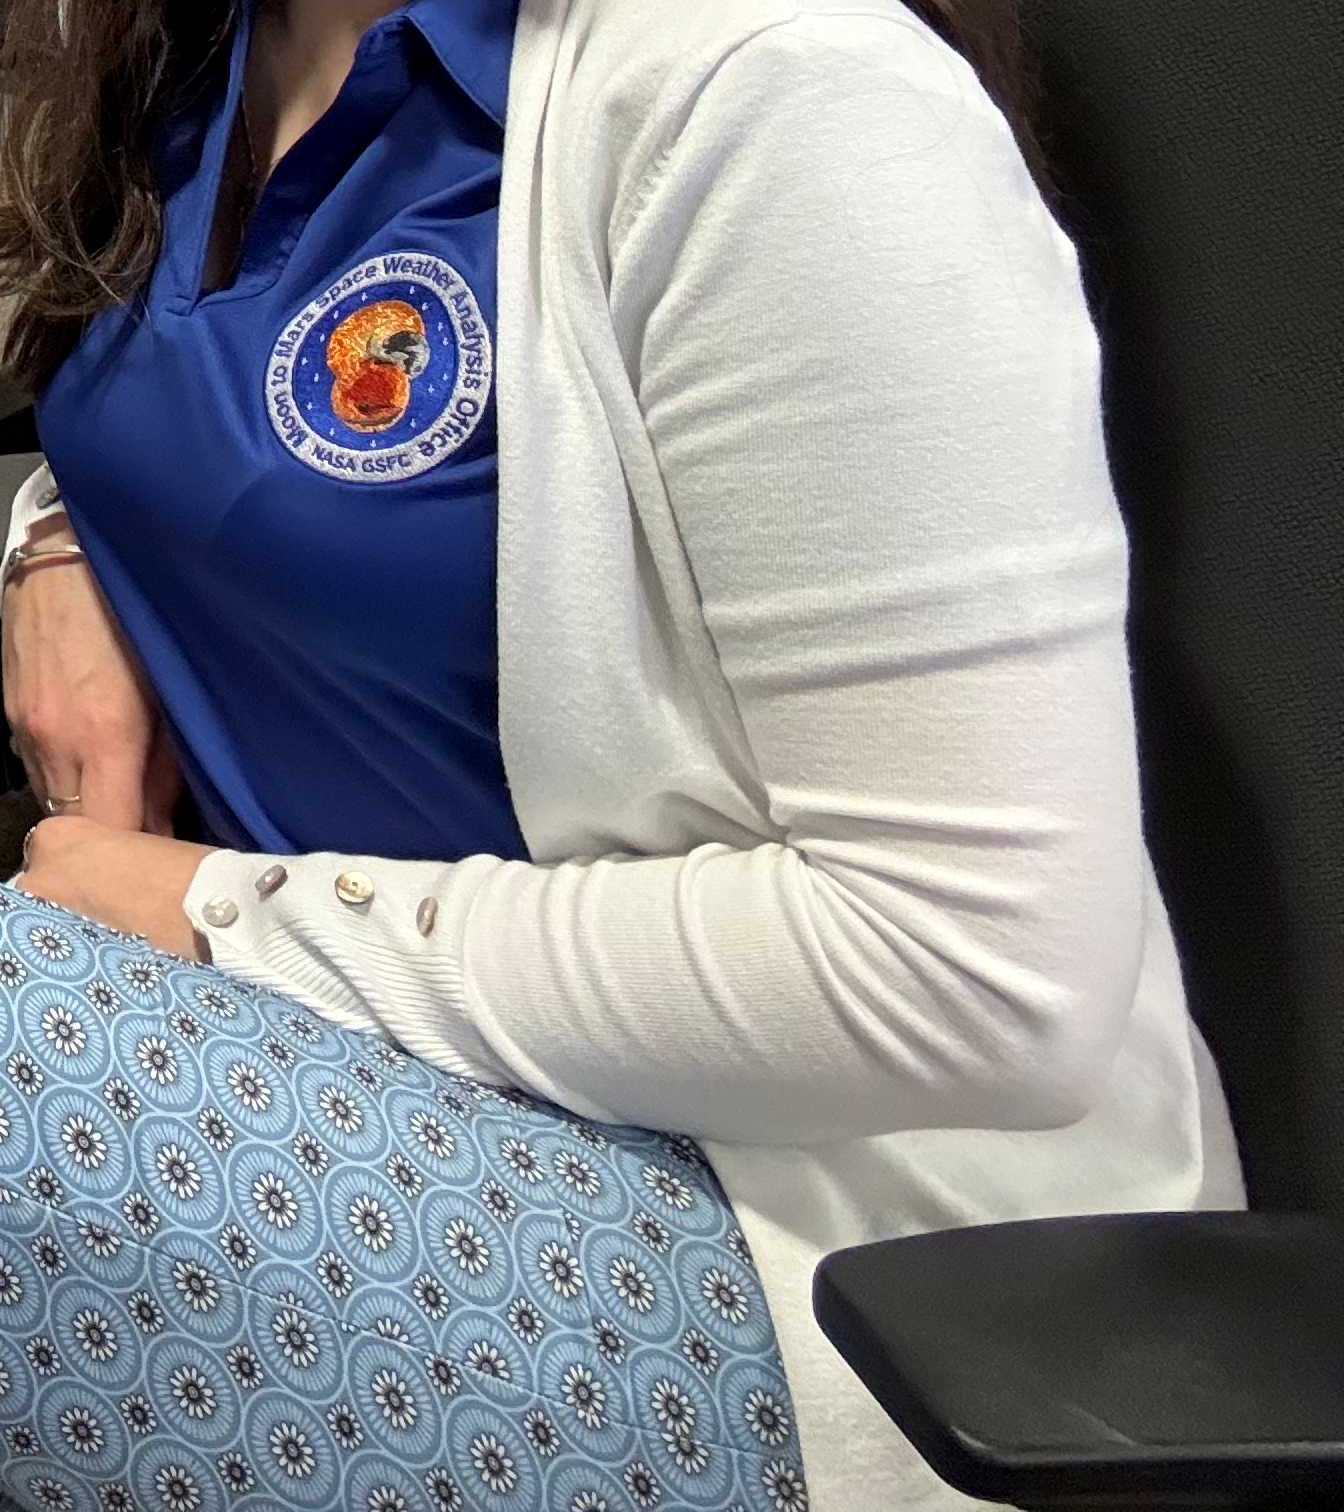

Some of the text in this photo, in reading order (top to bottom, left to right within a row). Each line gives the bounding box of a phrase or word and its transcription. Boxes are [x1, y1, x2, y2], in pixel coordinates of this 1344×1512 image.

[270, 256, 487, 457] Moon to Mars Space Weather Analysis Office
[311, 444, 413, 474] NASA GSFC
